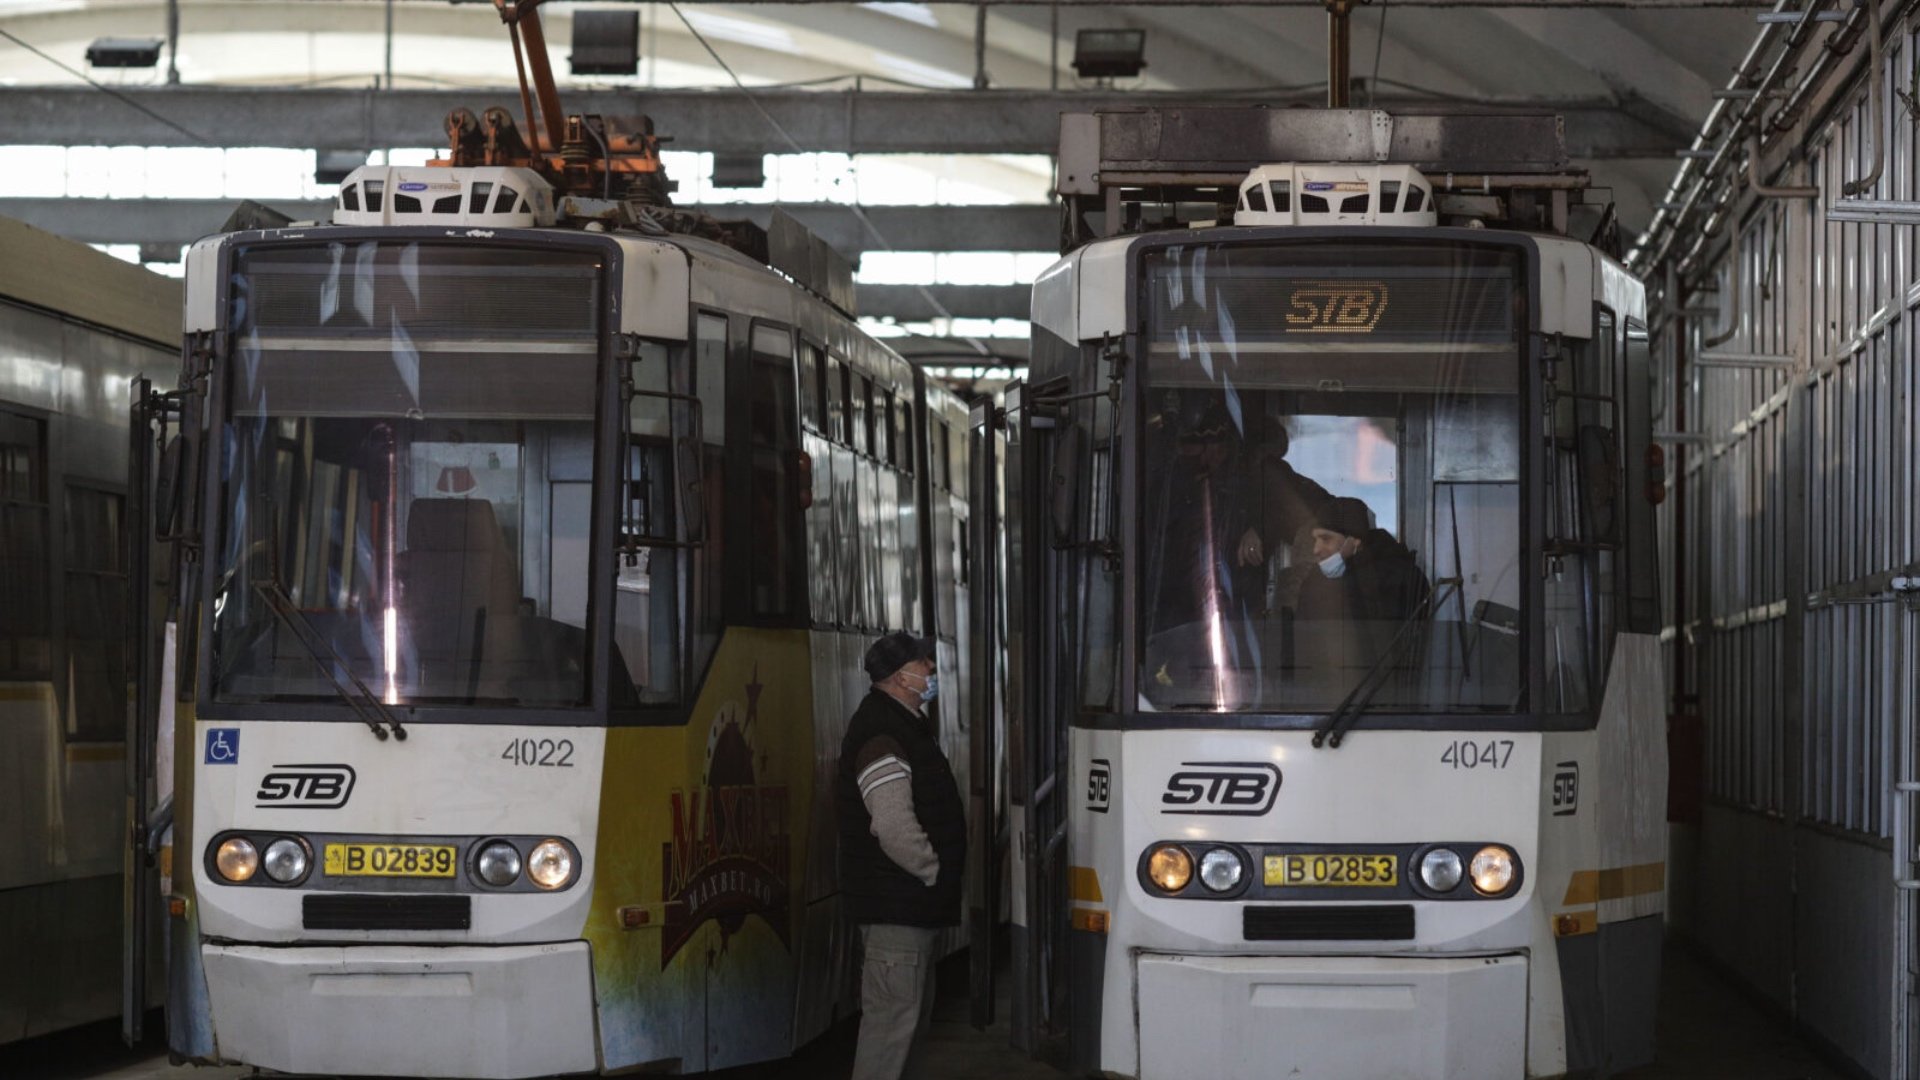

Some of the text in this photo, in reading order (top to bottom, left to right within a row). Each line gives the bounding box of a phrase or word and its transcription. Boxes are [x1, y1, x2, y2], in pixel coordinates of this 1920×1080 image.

[1285, 289, 1376, 323] STB
[502, 738, 574, 767] 4022
[1441, 740, 1514, 769] 4047
[256, 773, 346, 800] STB
[1088, 769, 1109, 802] STB
[1162, 772, 1270, 805] STB
[1553, 772, 1576, 806] STB
[347, 847, 452, 873] B 02839
[669, 785, 787, 902] MAXBET
[1287, 856, 1394, 882] B 02853
[689, 869, 772, 917] MAXBET.RO
